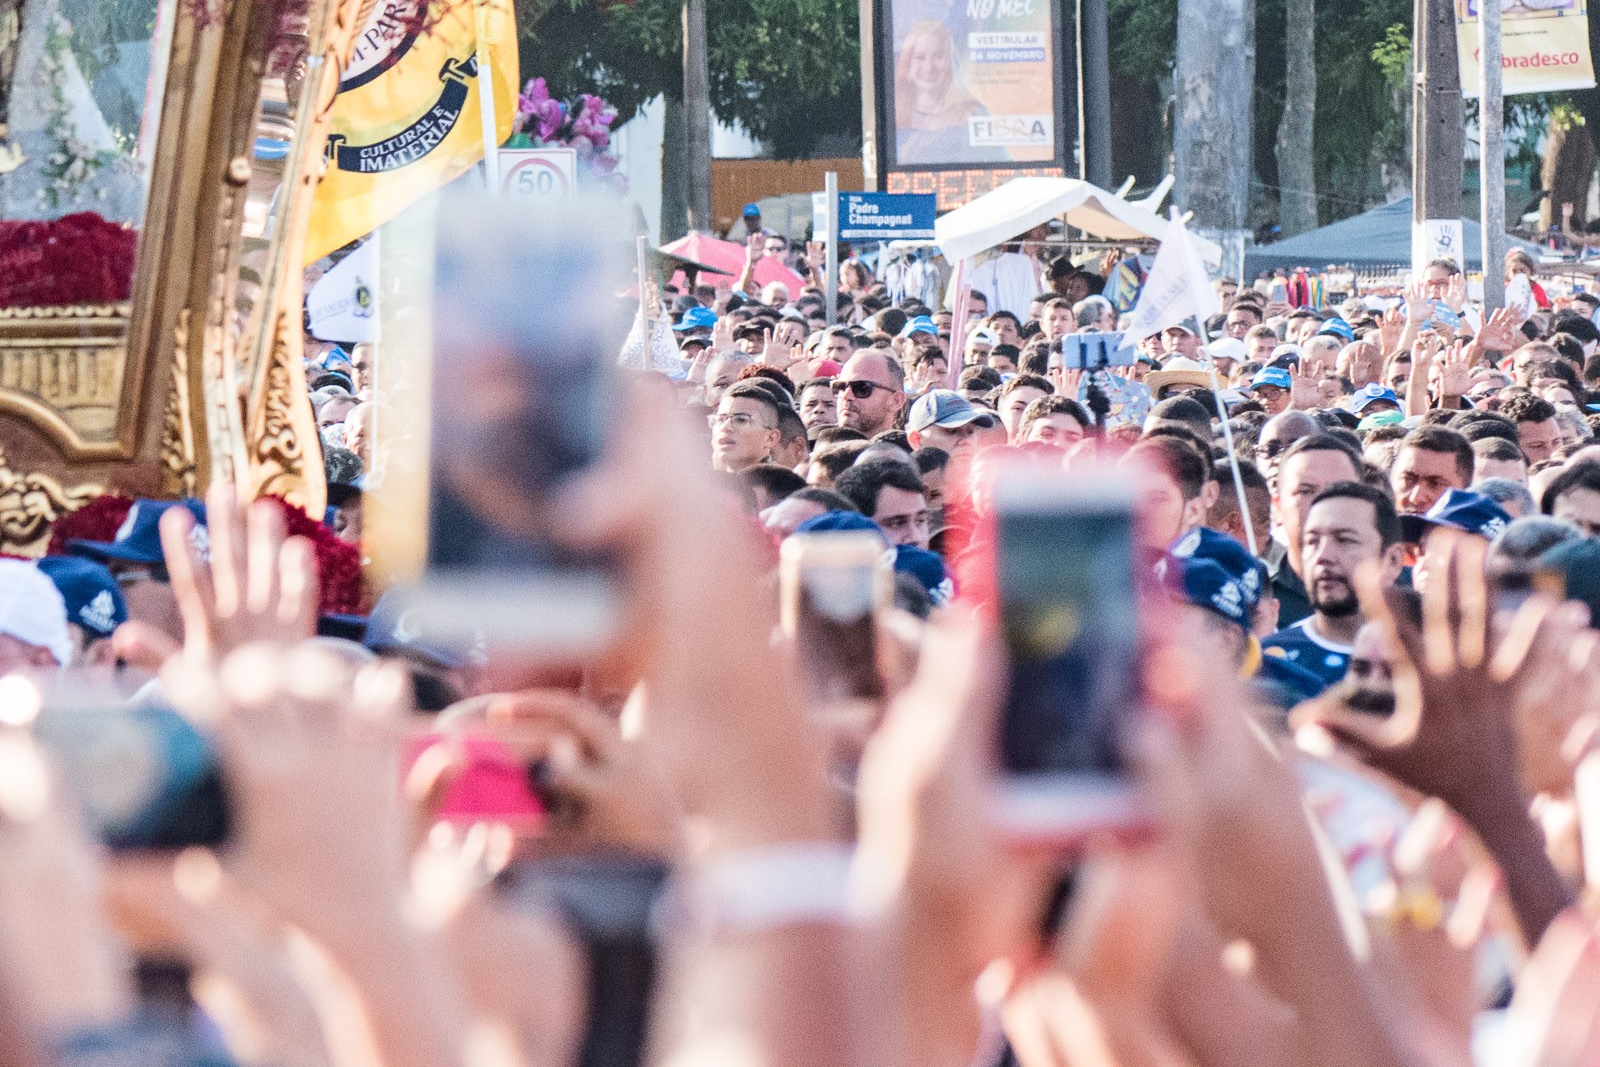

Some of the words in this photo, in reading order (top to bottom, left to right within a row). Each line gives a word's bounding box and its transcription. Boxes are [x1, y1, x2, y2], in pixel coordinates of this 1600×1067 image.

[976, 35, 1039, 45] VESTIBULAR
[986, 49, 1045, 61] NOVEMBRO
[1501, 51, 1579, 69] bradesco
[360, 119, 434, 158] CULTURAL
[432, 105, 445, 118] E
[360, 109, 459, 172] IMATERIAL
[518, 170, 553, 195] 50
[849, 202, 879, 214] Padre
[849, 214, 913, 227] Champagnat
